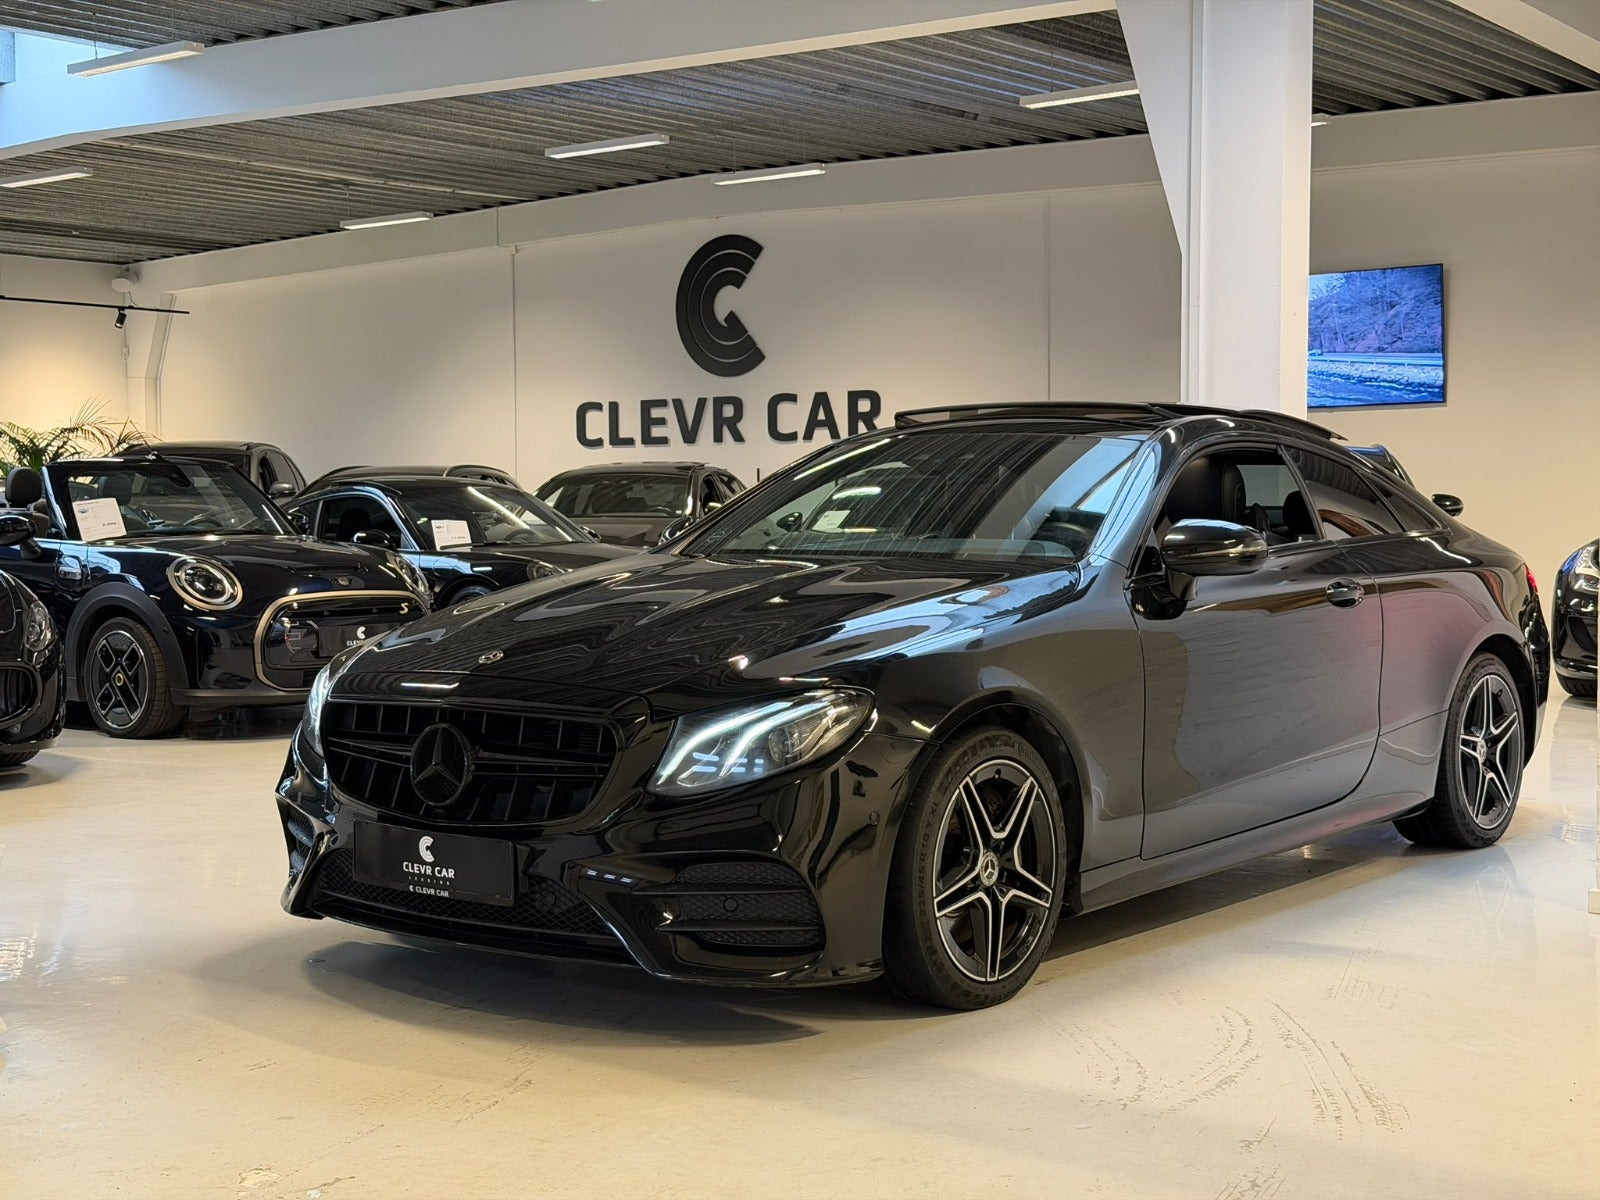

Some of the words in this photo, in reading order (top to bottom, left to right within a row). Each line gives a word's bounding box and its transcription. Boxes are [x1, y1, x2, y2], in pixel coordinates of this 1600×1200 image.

[576, 396, 745, 447] CLEVR
[767, 390, 882, 441] CAR
[403, 861, 433, 876] CLEVR
[434, 866, 455, 879] CAR
[415, 886, 436, 896] CLEVR
[436, 889, 450, 898] CAR
